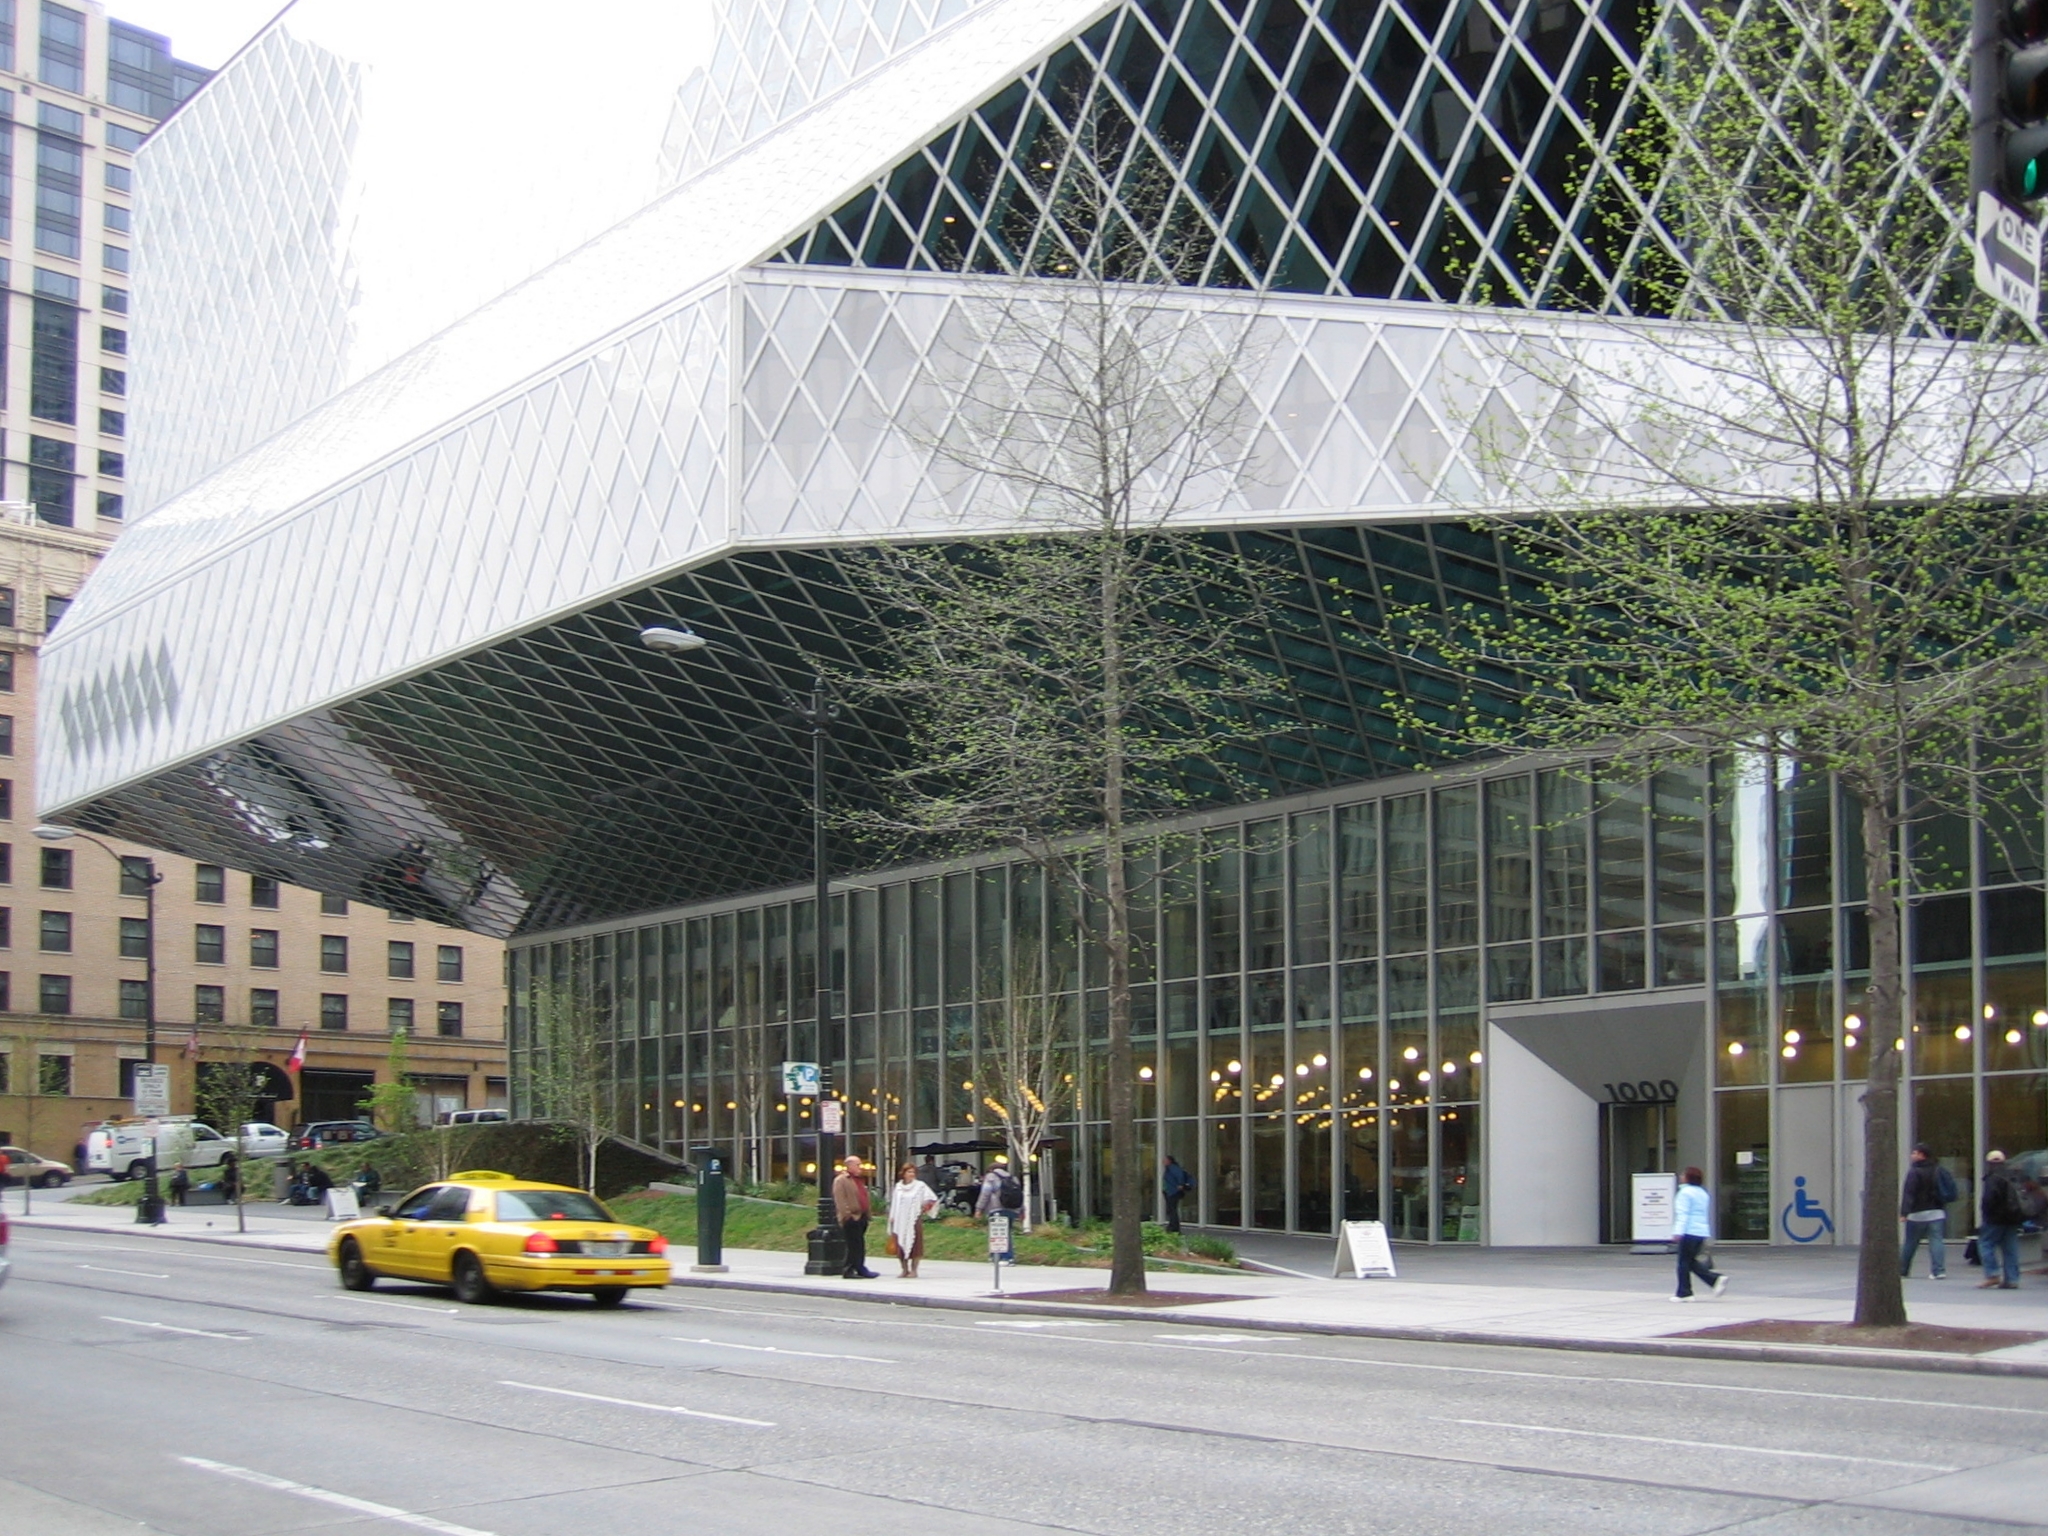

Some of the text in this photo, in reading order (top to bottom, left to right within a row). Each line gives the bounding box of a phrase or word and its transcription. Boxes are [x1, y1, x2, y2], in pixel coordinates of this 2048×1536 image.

[2003, 215, 2035, 255] ONE
[2001, 274, 2031, 312] WAY
[1603, 1079, 1679, 1102] 1000
[711, 1158, 721, 1170] P
